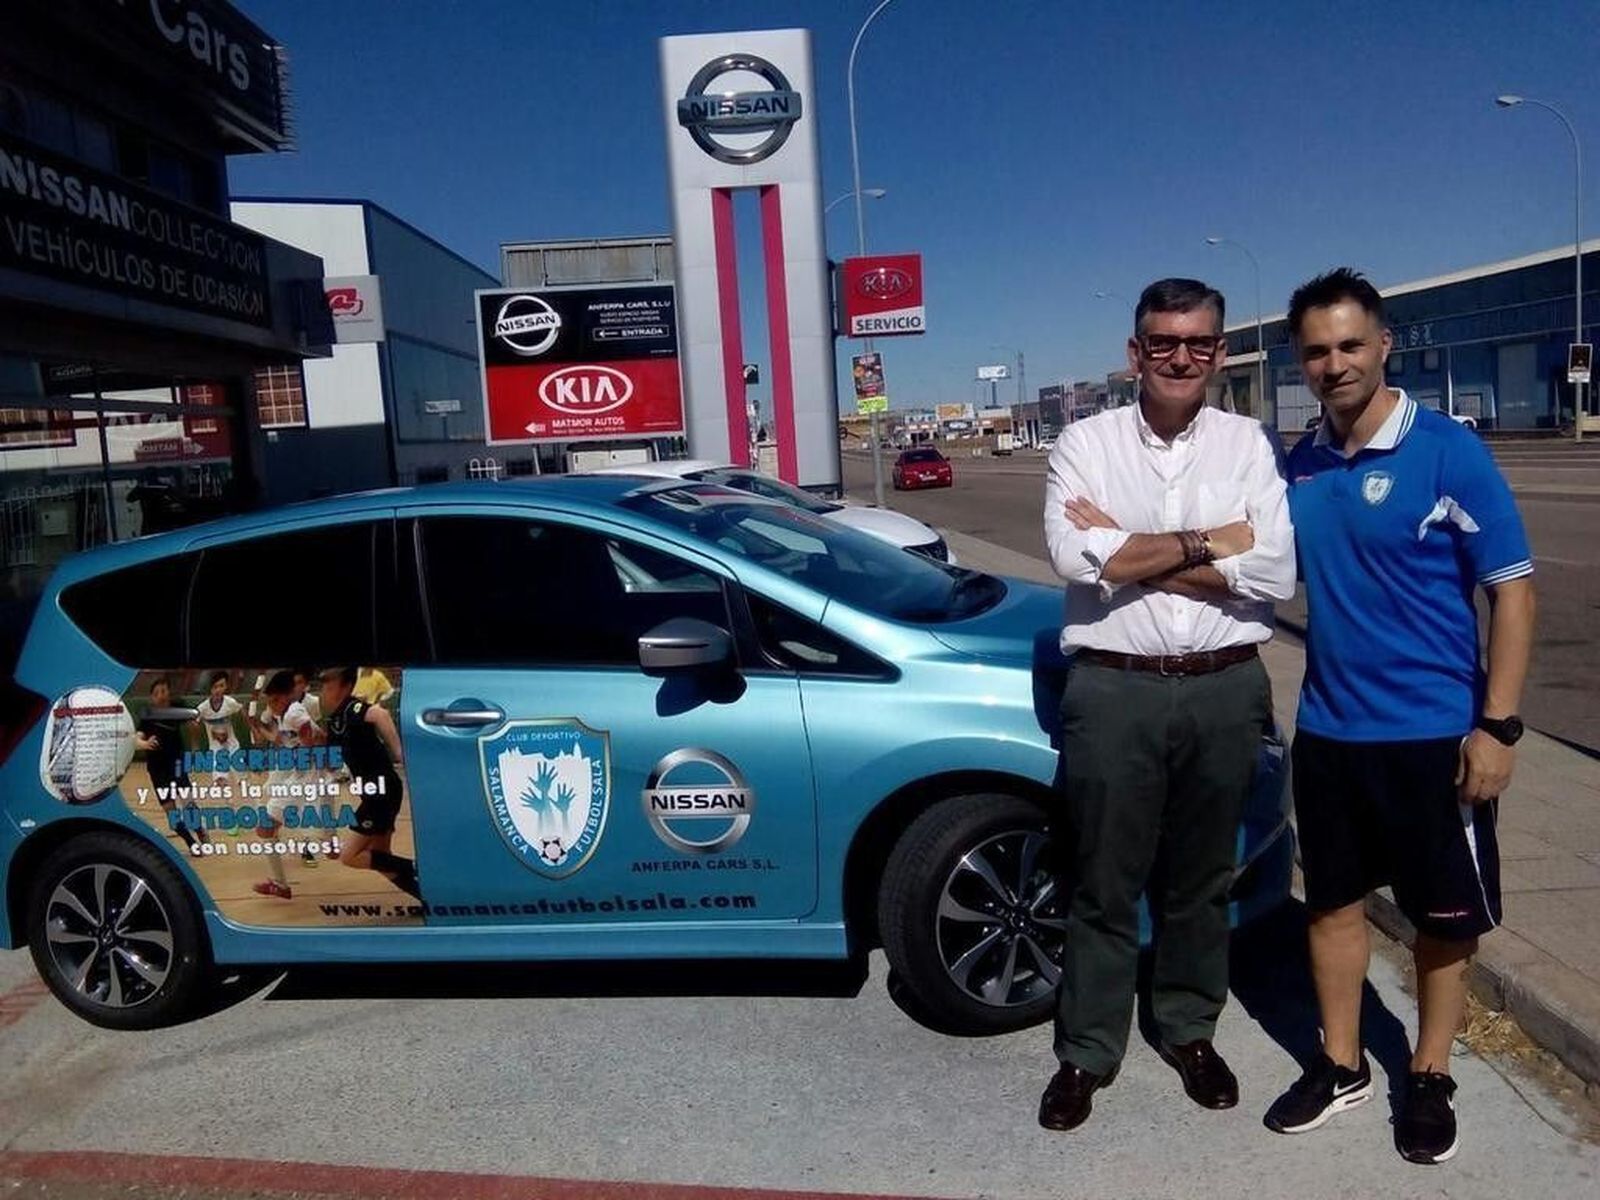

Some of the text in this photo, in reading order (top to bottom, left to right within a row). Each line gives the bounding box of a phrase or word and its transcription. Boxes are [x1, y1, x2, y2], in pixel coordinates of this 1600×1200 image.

[152, 0, 250, 91] Cars
[691, 97, 790, 119] NISSAN
[161, 264, 189, 298] DE
[497, 314, 556, 333] NISSAN
[621, 328, 664, 338] ENTRADA
[856, 316, 922, 332] SERVICIO
[555, 376, 618, 404] KIA
[552, 416, 625, 428] MATMOR AUTOS
[506, 731, 581, 742] CLUB DEPORTIVO
[591, 759, 604, 797] SALA
[137, 776, 386, 804] y vivirás la magia del
[488, 767, 529, 854] SALAMANCA
[651, 793, 746, 810] NISSAN
[283, 805, 360, 829] SALA
[191, 835, 341, 856] con nosotros!
[632, 861, 702, 872] ANFERPA
[706, 859, 748, 870] CARS
